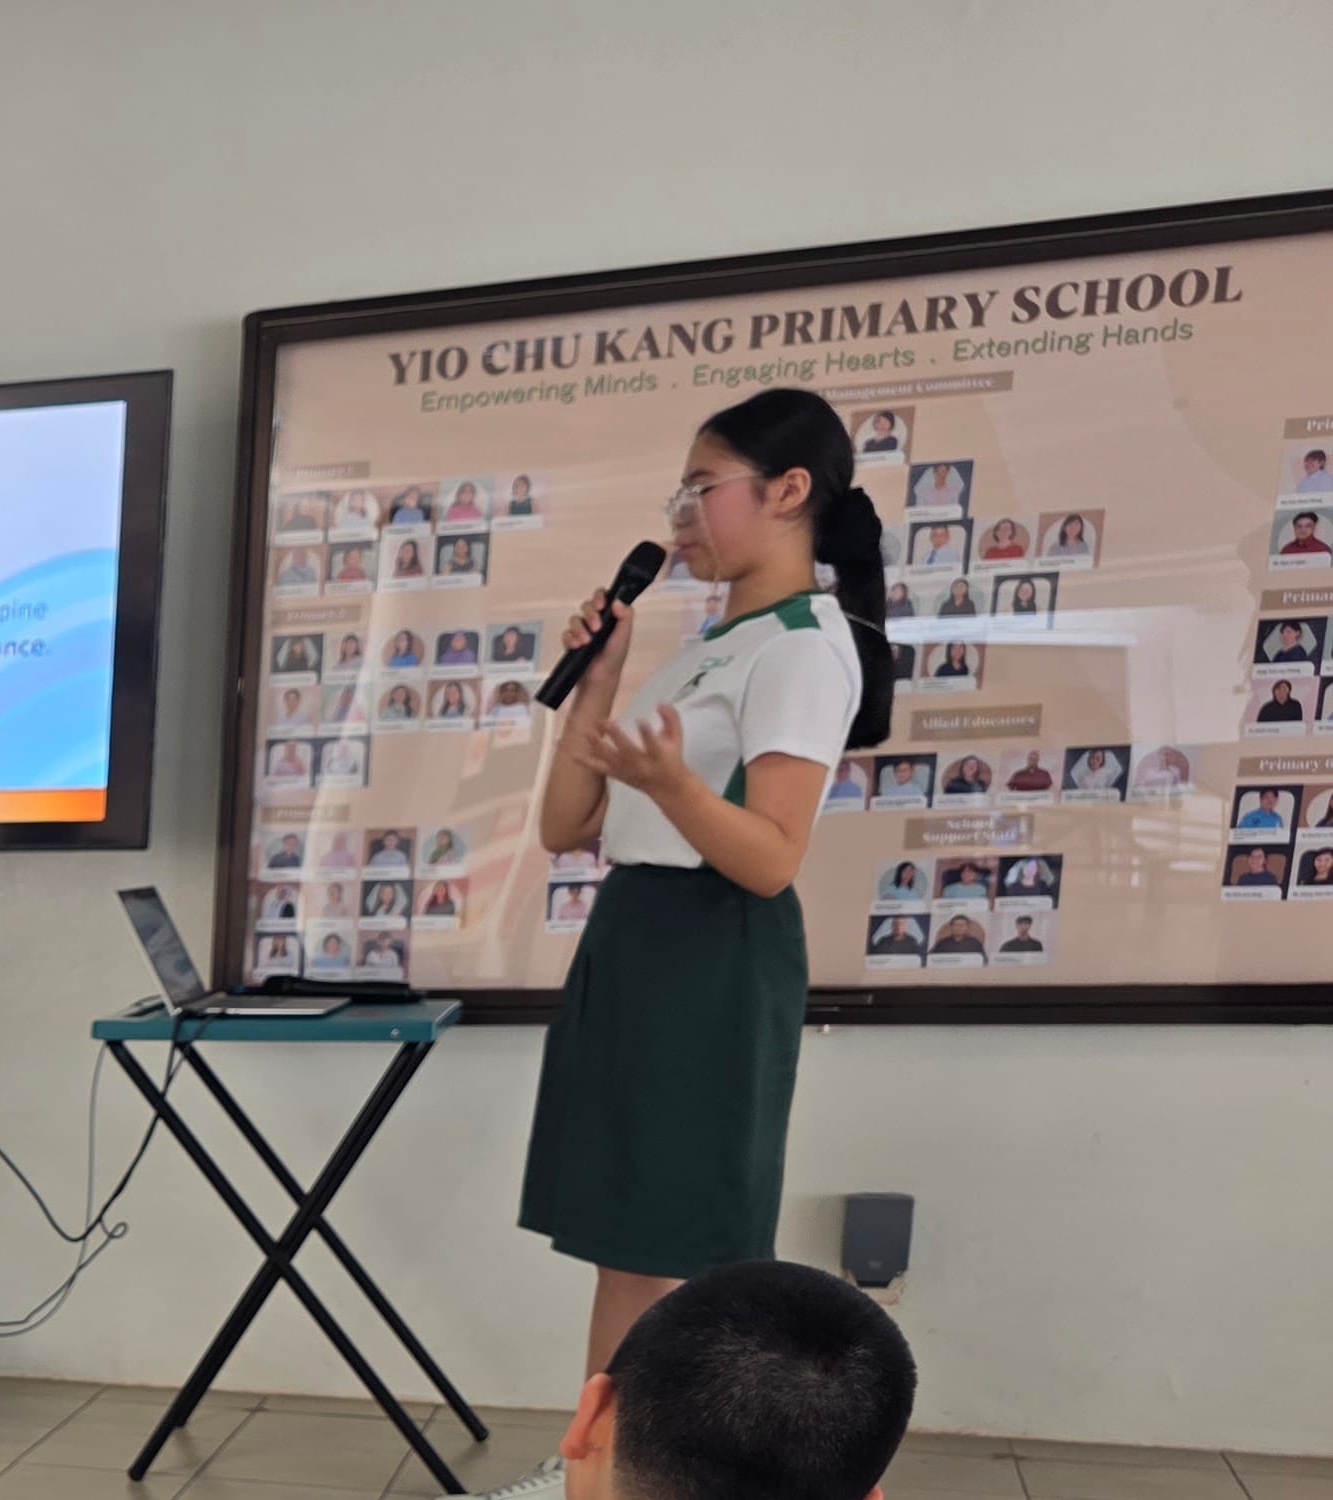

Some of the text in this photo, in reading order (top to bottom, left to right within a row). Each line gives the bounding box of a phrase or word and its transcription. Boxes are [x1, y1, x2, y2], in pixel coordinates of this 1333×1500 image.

[388, 265, 1243, 386] YIO CHU KANG PRIMARY SCHOOL
[420, 318, 1195, 414] Empowering Minds Engaging Hearts Extending Hands
